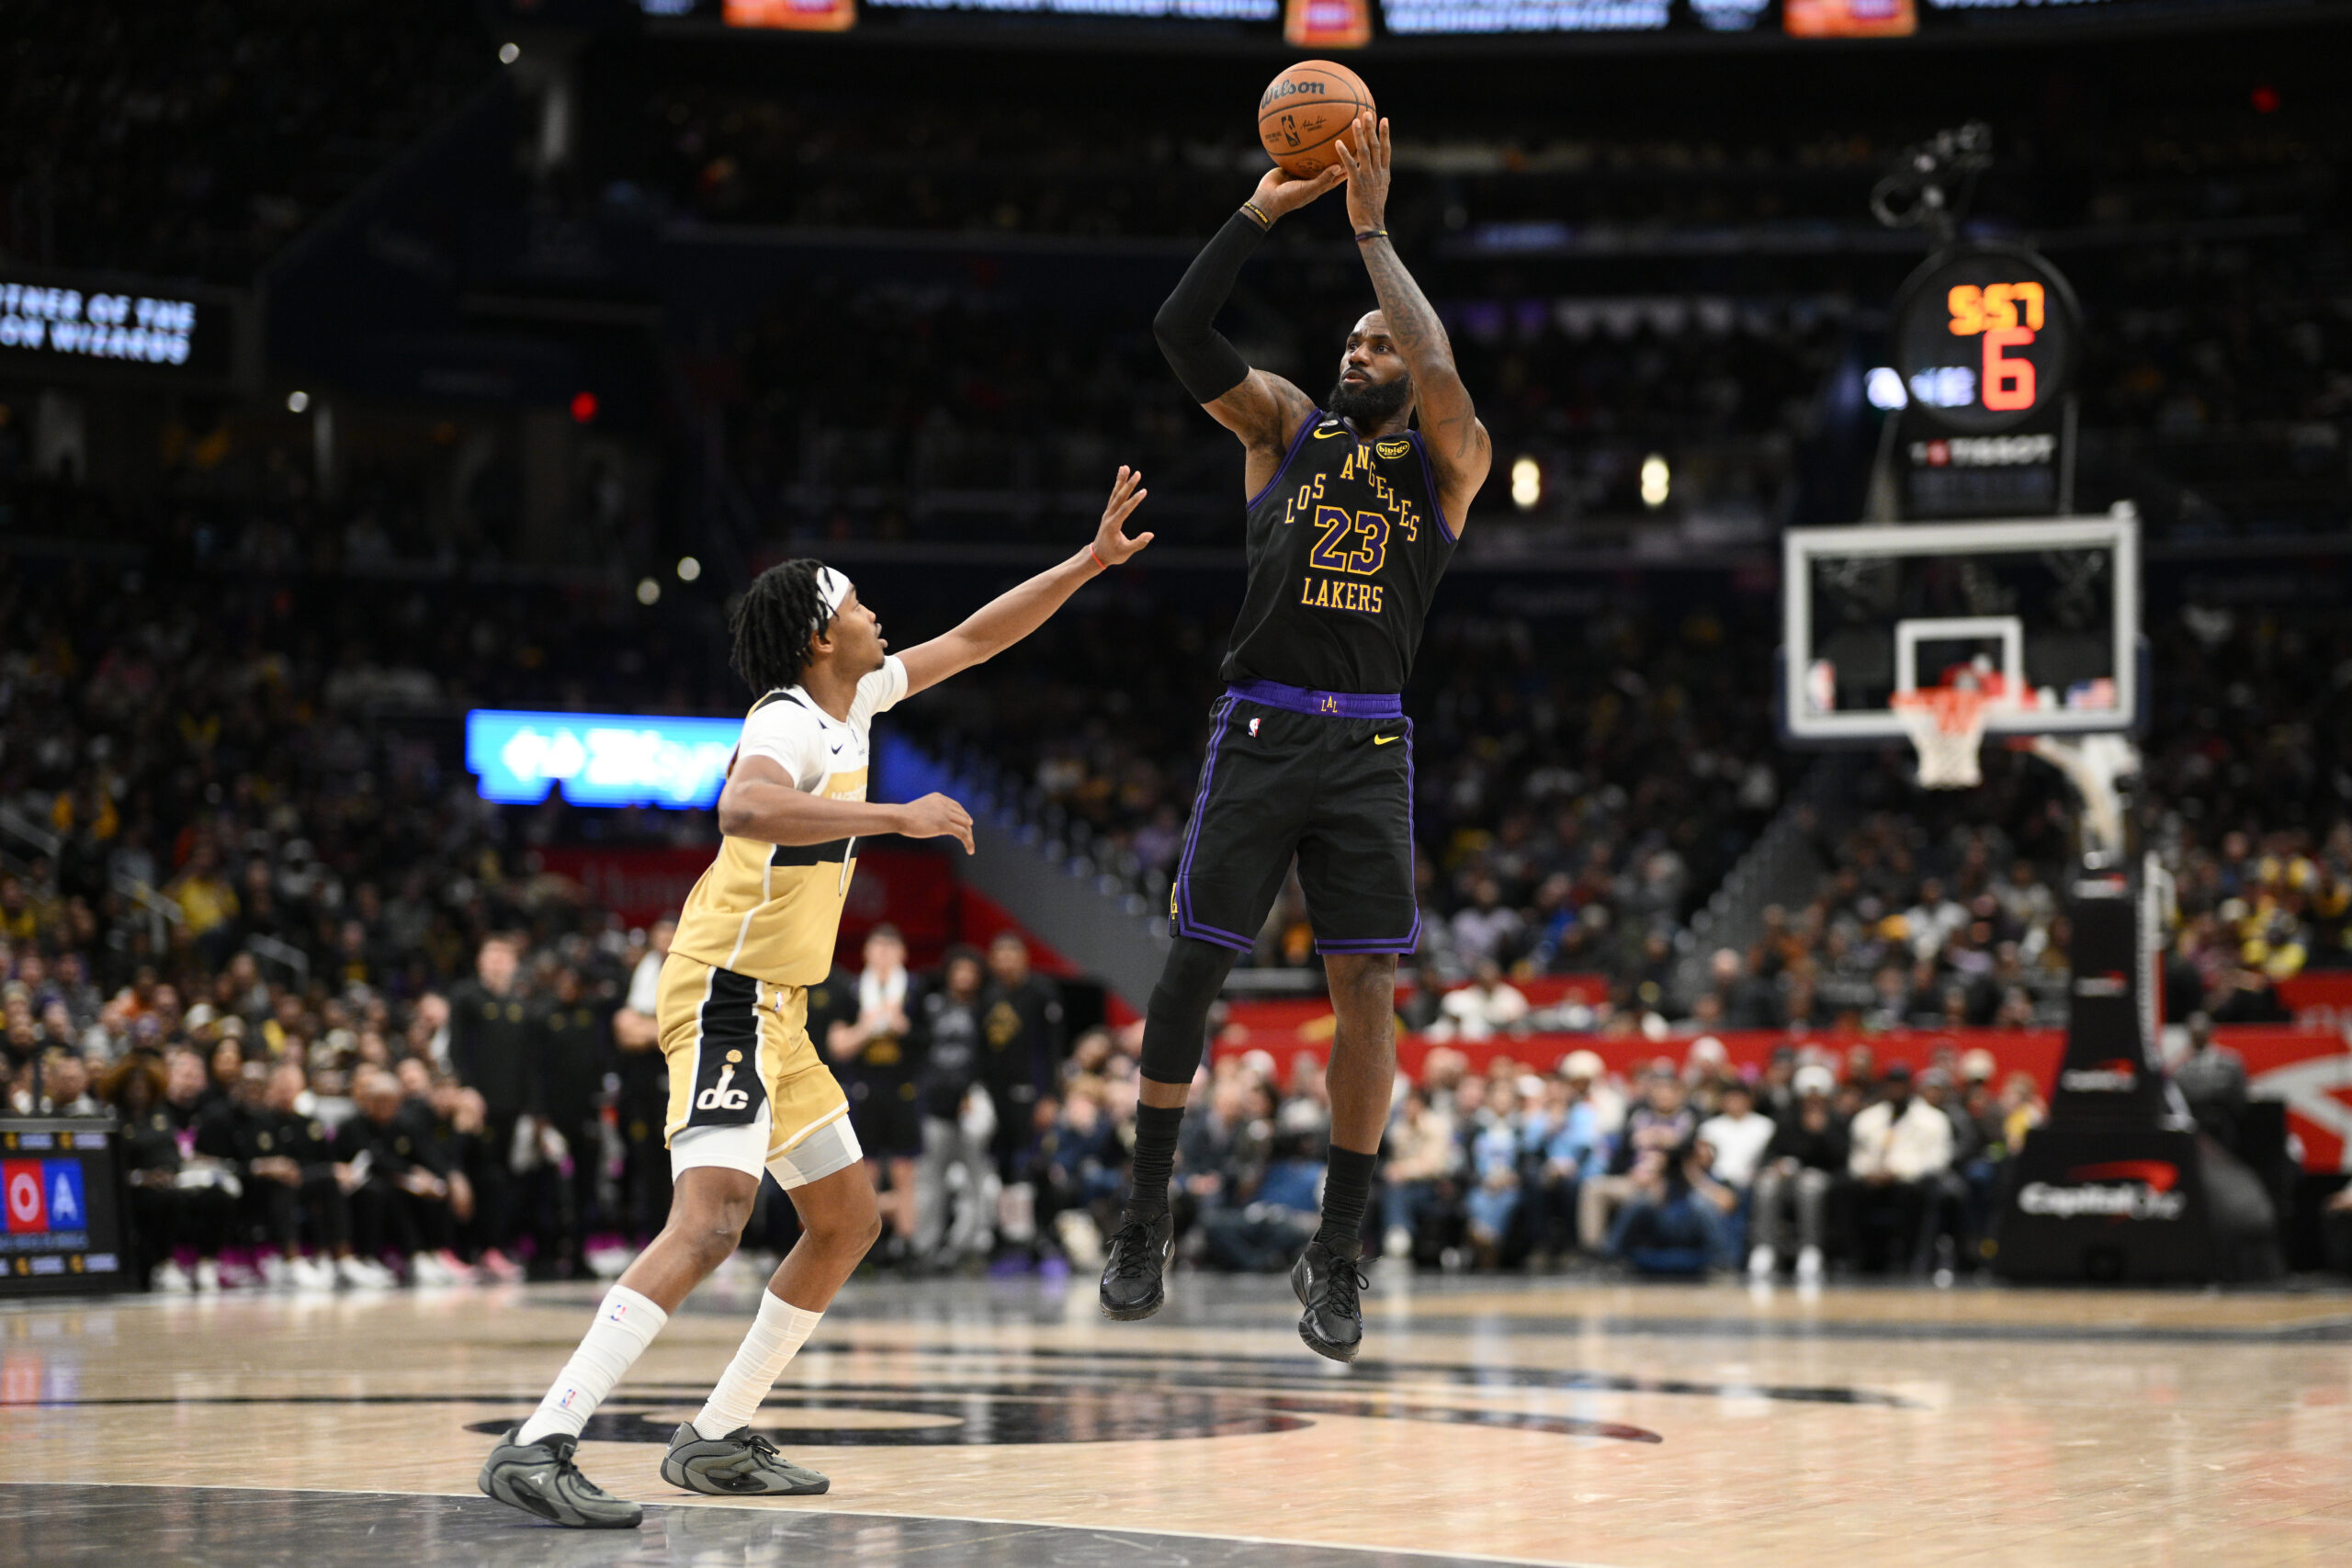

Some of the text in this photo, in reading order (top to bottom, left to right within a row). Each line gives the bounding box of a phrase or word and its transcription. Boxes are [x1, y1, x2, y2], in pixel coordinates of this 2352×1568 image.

[1261, 79, 1325, 109] Wilson
[1982, 325, 2036, 411] 6
[1378, 445, 1408, 454] bibigo
[1284, 444, 1420, 542] LOS ANGELES
[1309, 504, 1390, 576] 23
[1300, 577, 1384, 614] LAKERS
[1320, 695, 1339, 713] LAL
